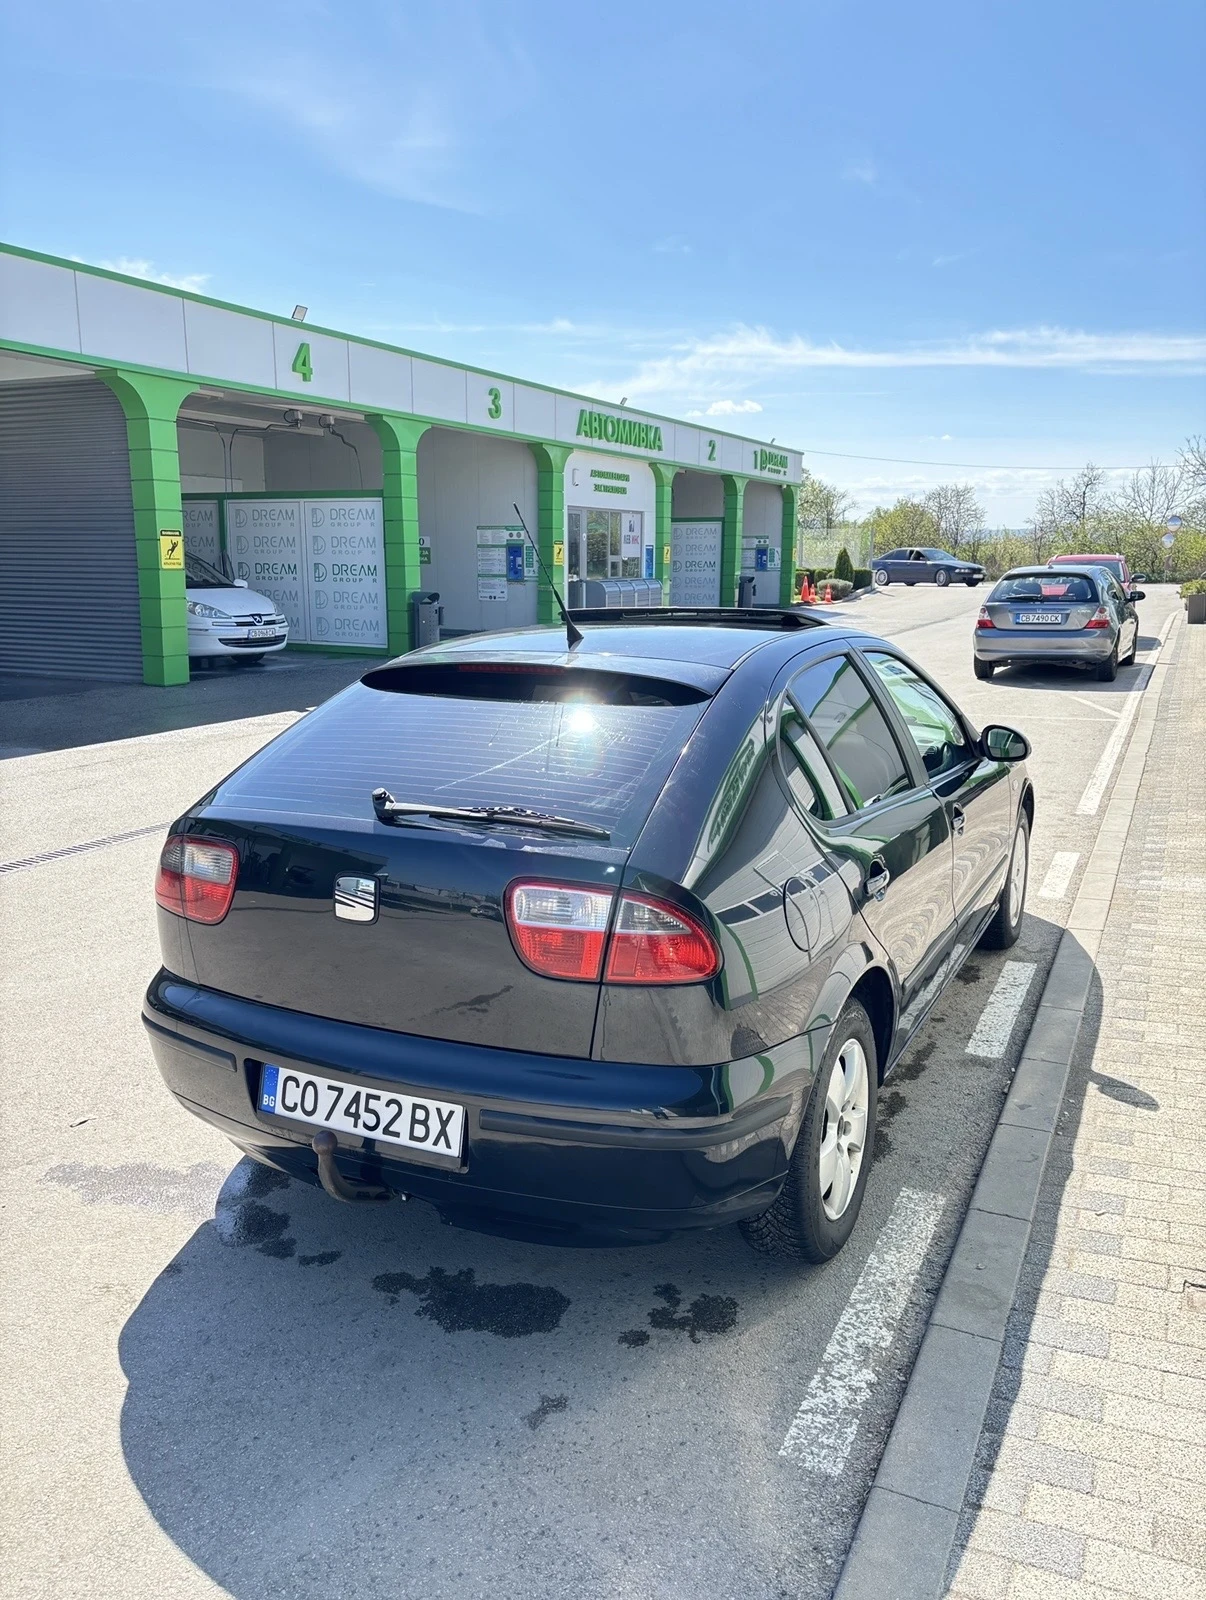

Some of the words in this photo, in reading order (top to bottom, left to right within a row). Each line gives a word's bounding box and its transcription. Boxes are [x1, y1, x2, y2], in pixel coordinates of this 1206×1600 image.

[292, 343, 313, 382] 4
[488, 388, 502, 419] 3
[576, 409, 663, 451] АВТОМИВКА
[708, 440, 716, 461] 2
[753, 450, 758, 469] 1
[768, 452, 788, 469] DREAM
[184, 509, 213, 521] REAM
[252, 509, 295, 521] DREAM
[330, 508, 376, 520] DREAM
[685, 527, 717, 535] DREAM
[253, 536, 296, 548] DREAM
[331, 536, 377, 548] DREAM
[685, 544, 716, 552] DREAM
[254, 562, 297, 575] DREAM
[332, 563, 377, 576] DREAM
[685, 560, 716, 568] DREAM
[684, 576, 715, 584] DREAM
[333, 590, 379, 604] DREAM
[684, 593, 715, 601] DREAM
[334, 618, 380, 632] DREAM
[263, 1094, 275, 1107] BG
